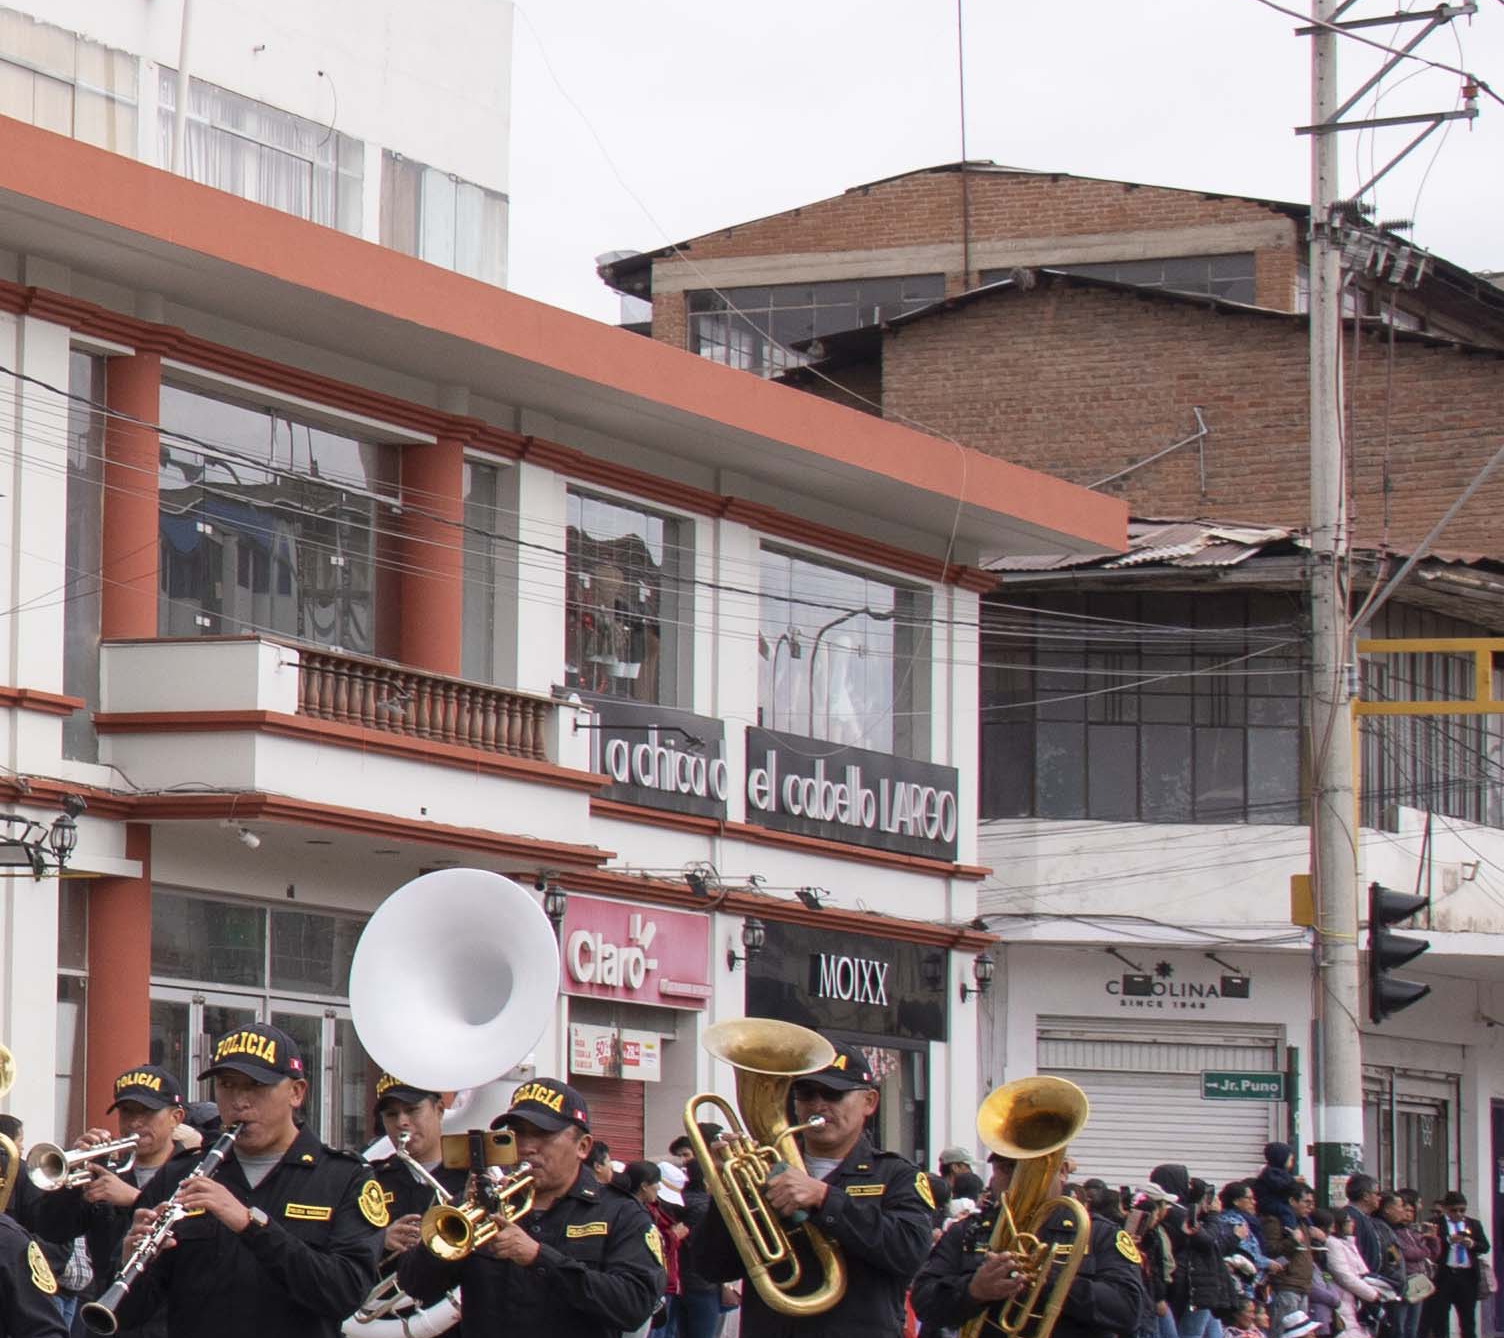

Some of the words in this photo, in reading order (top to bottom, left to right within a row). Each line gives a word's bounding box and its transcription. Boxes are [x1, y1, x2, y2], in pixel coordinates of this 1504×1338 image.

[782, 759, 876, 829] cabello
[880, 778, 957, 843] LARGO
[567, 927, 647, 990] Claro
[818, 953, 889, 1007] MOIXX
[1105, 979, 1221, 999] COLINA
[1120, 999, 1163, 1009] SINCE
[214, 1031, 277, 1065] POLICIA
[1220, 1079, 1240, 1092] Jr.
[1241, 1079, 1280, 1093] Puno
